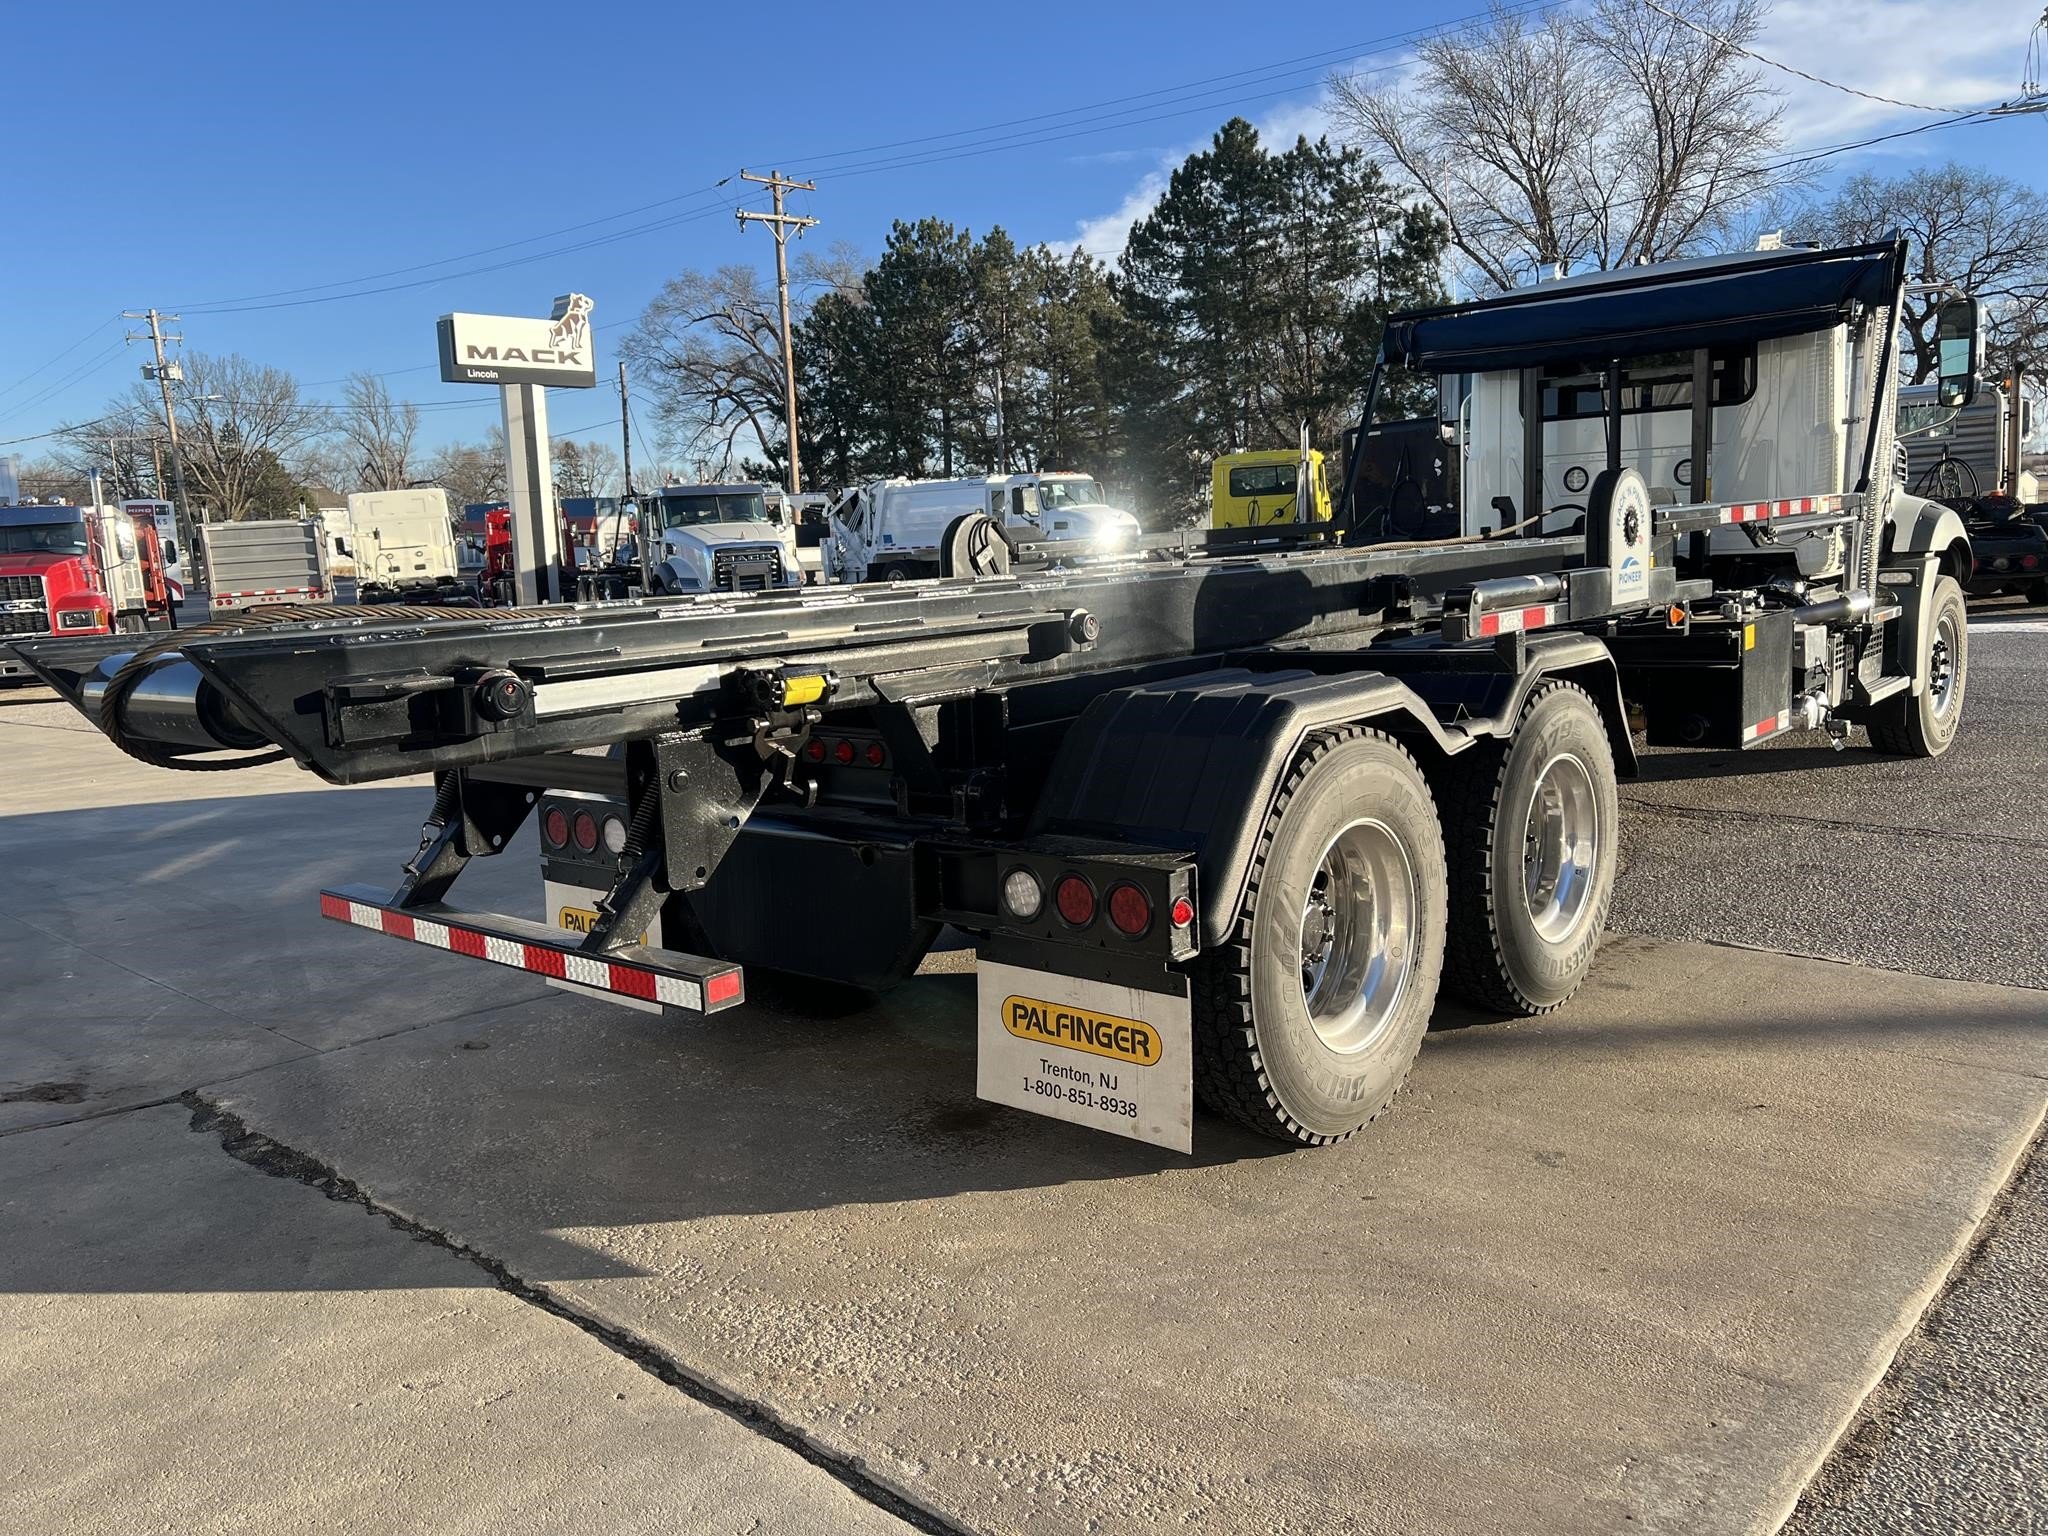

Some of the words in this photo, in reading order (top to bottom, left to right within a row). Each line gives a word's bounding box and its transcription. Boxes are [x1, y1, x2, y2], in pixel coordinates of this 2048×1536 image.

[467, 345, 582, 365] MACK
[467, 368, 499, 379] Lincoln
[1618, 570, 1642, 585] PIONEER
[1280, 925, 1367, 1102] BRIDGESTONE
[1012, 1003, 1150, 1058] PALFINGER
[1040, 1058, 1095, 1087] Trenton,
[1099, 1072, 1118, 1090] NJ
[1023, 1077, 1138, 1118] 1-800-851-8938
